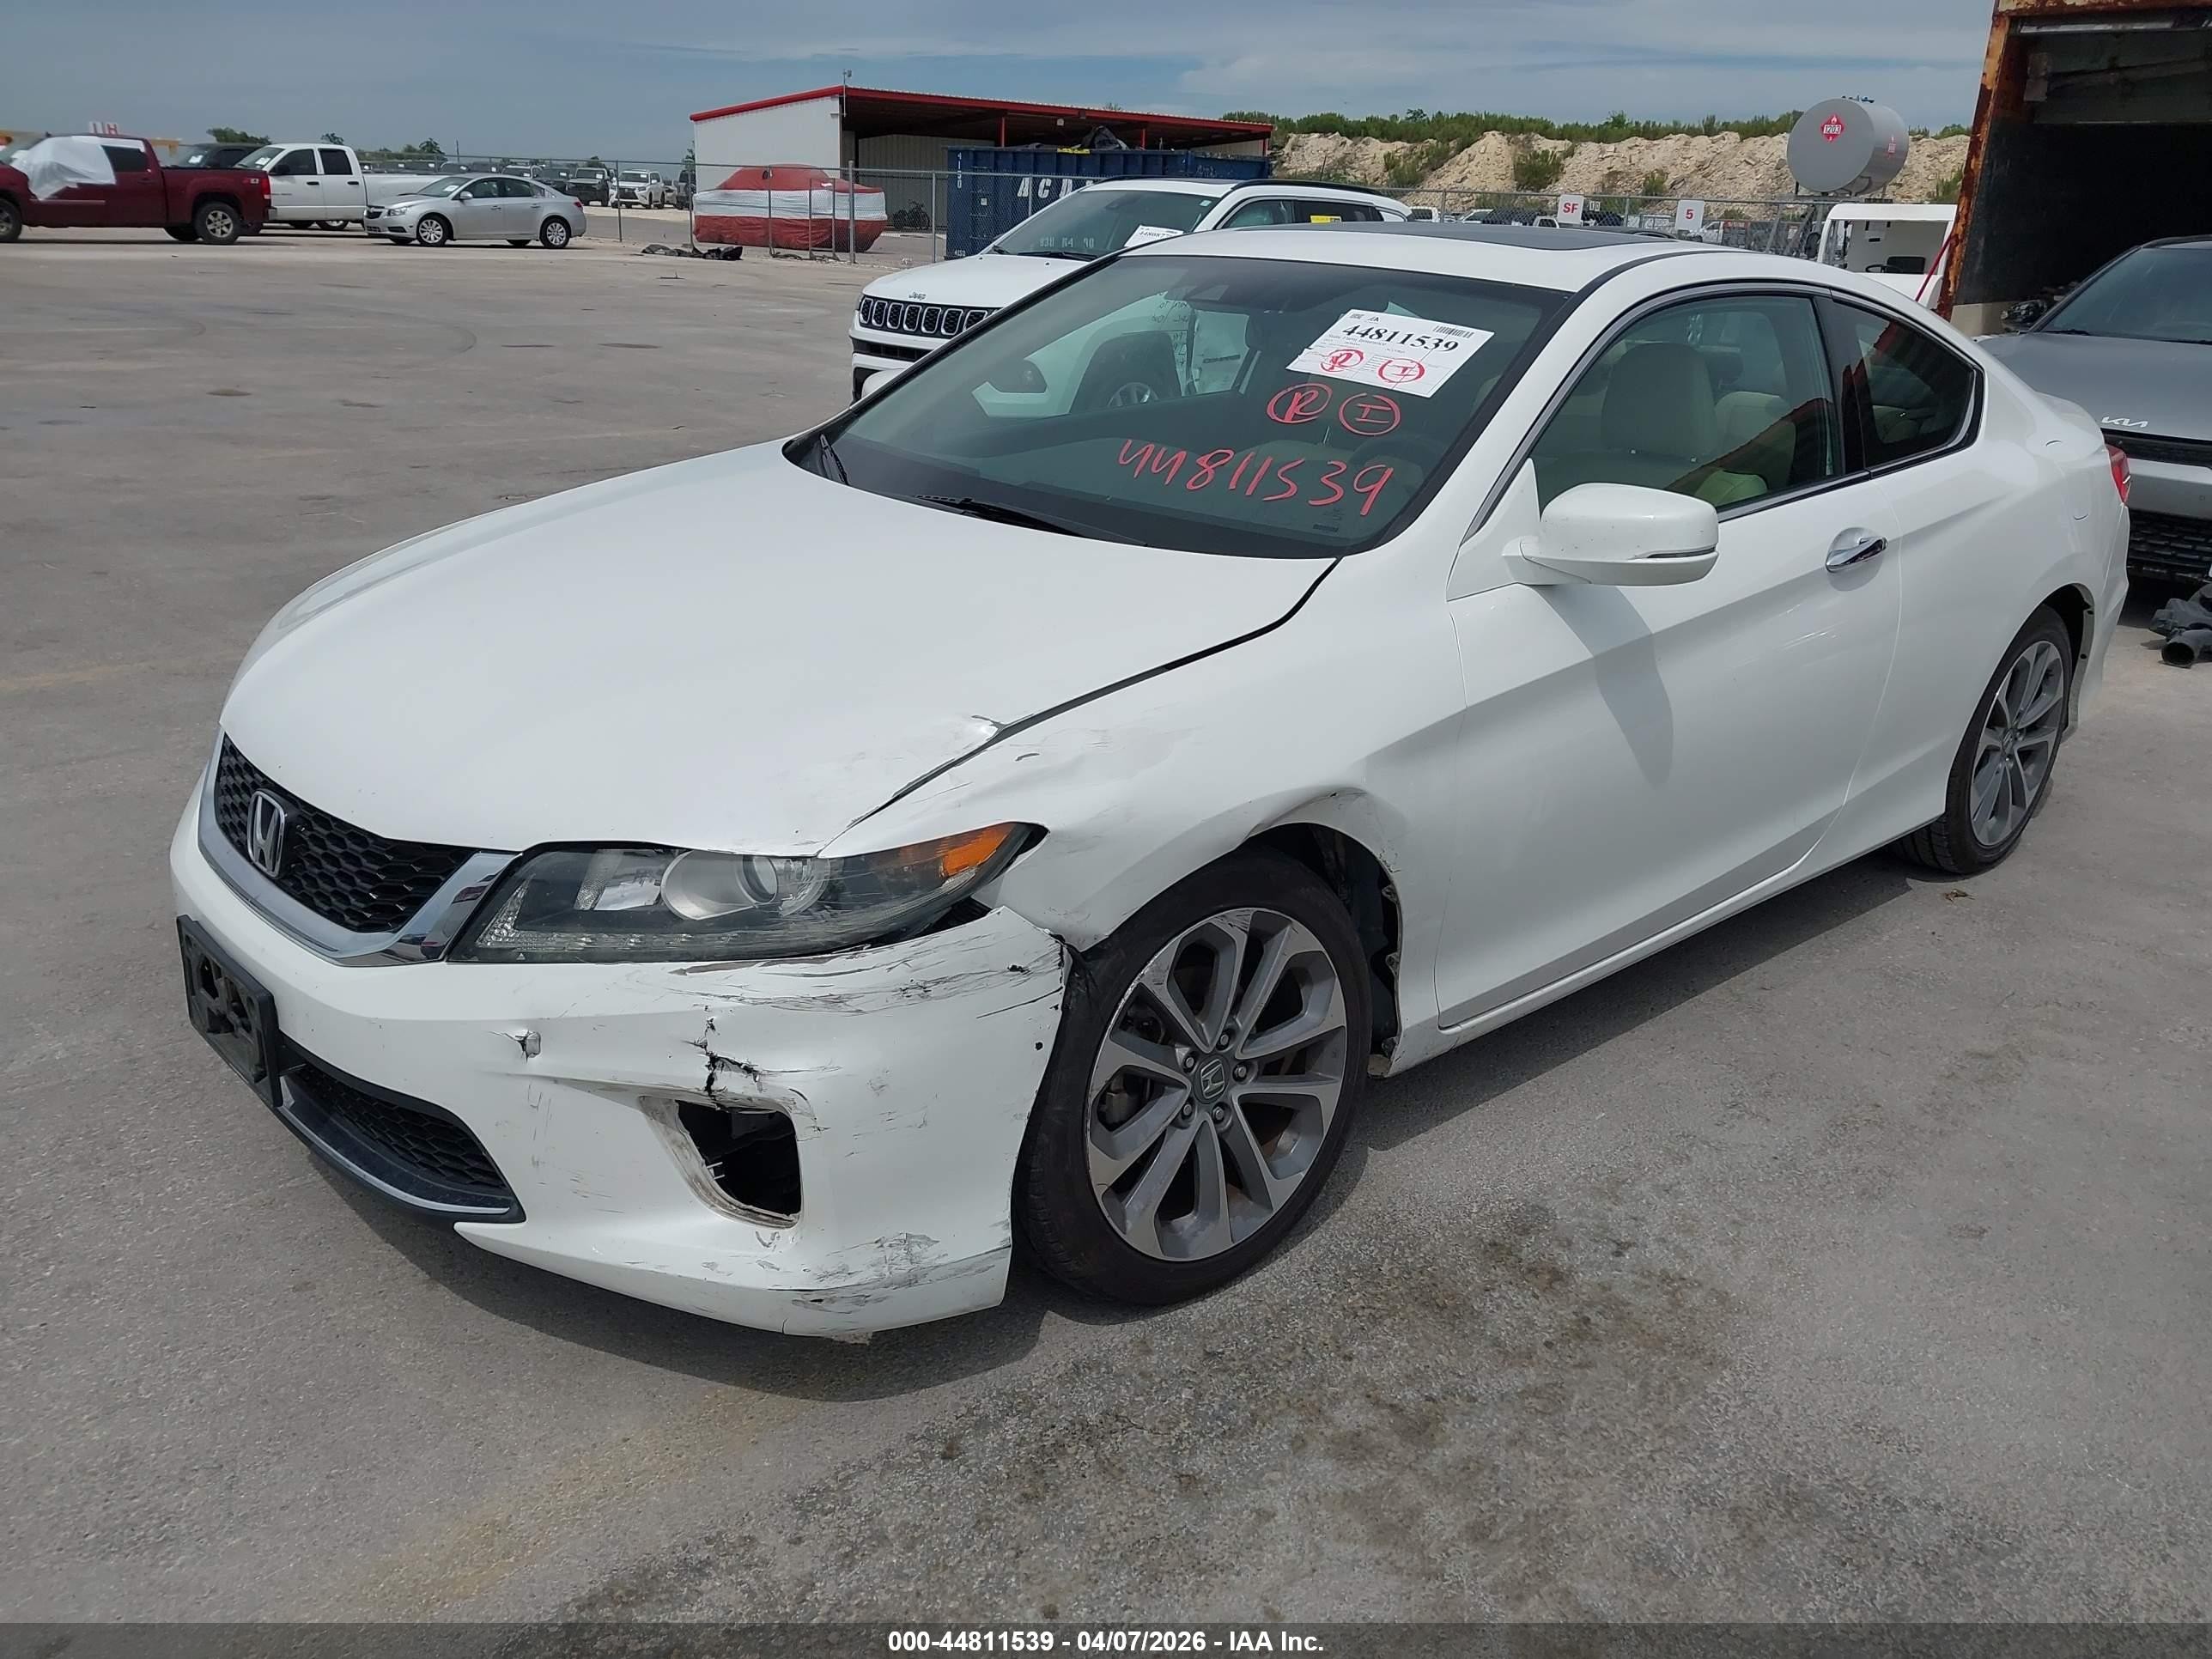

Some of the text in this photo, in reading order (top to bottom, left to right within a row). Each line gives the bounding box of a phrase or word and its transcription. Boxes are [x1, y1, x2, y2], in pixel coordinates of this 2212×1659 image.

[1018, 177, 1094, 199] ACA
[1563, 202, 1579, 214] SF
[1686, 209, 1694, 220] 5
[908, 292, 927, 301] Jeep
[1342, 325, 1459, 352] 44811539
[1118, 438, 1395, 516] 44811539
